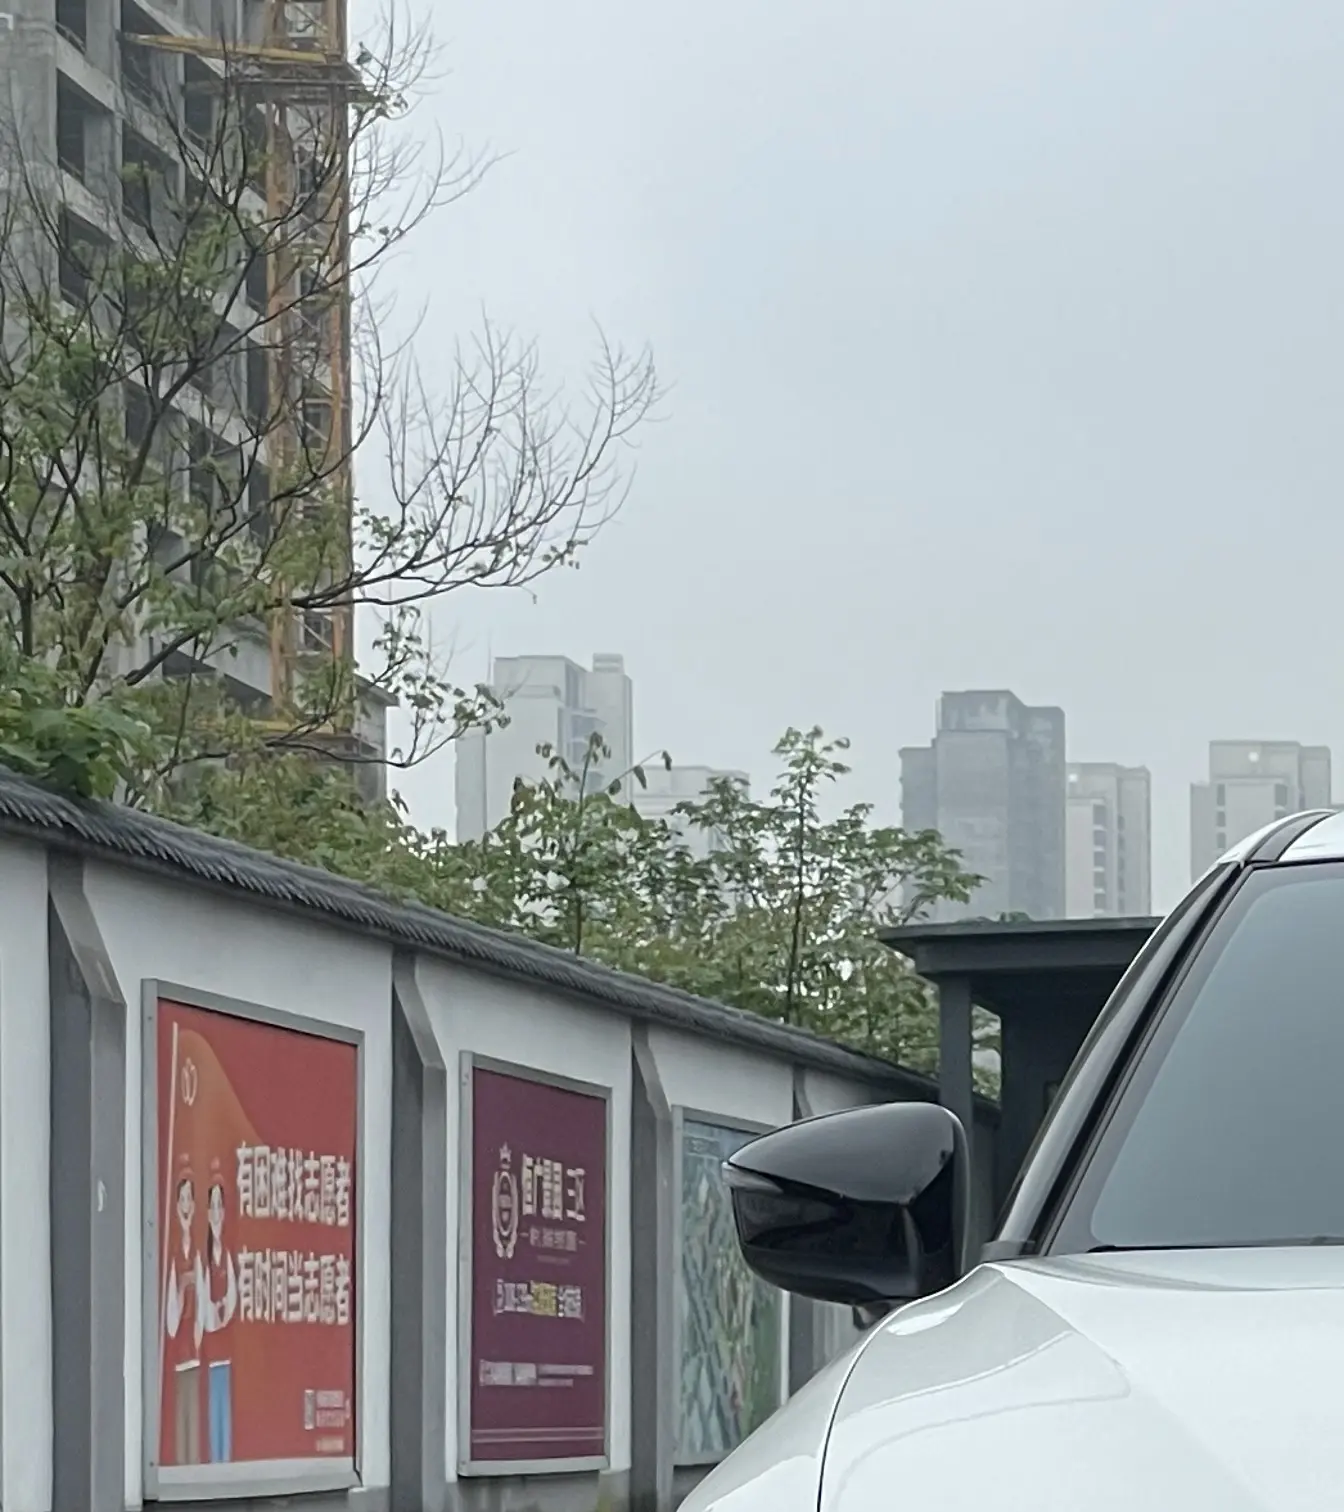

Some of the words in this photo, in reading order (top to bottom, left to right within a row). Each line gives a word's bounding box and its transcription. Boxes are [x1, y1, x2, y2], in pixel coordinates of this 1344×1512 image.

[236, 1140, 351, 1227] 有困难找志愿者
[237, 1245, 351, 1326] 有时间当志愿者
